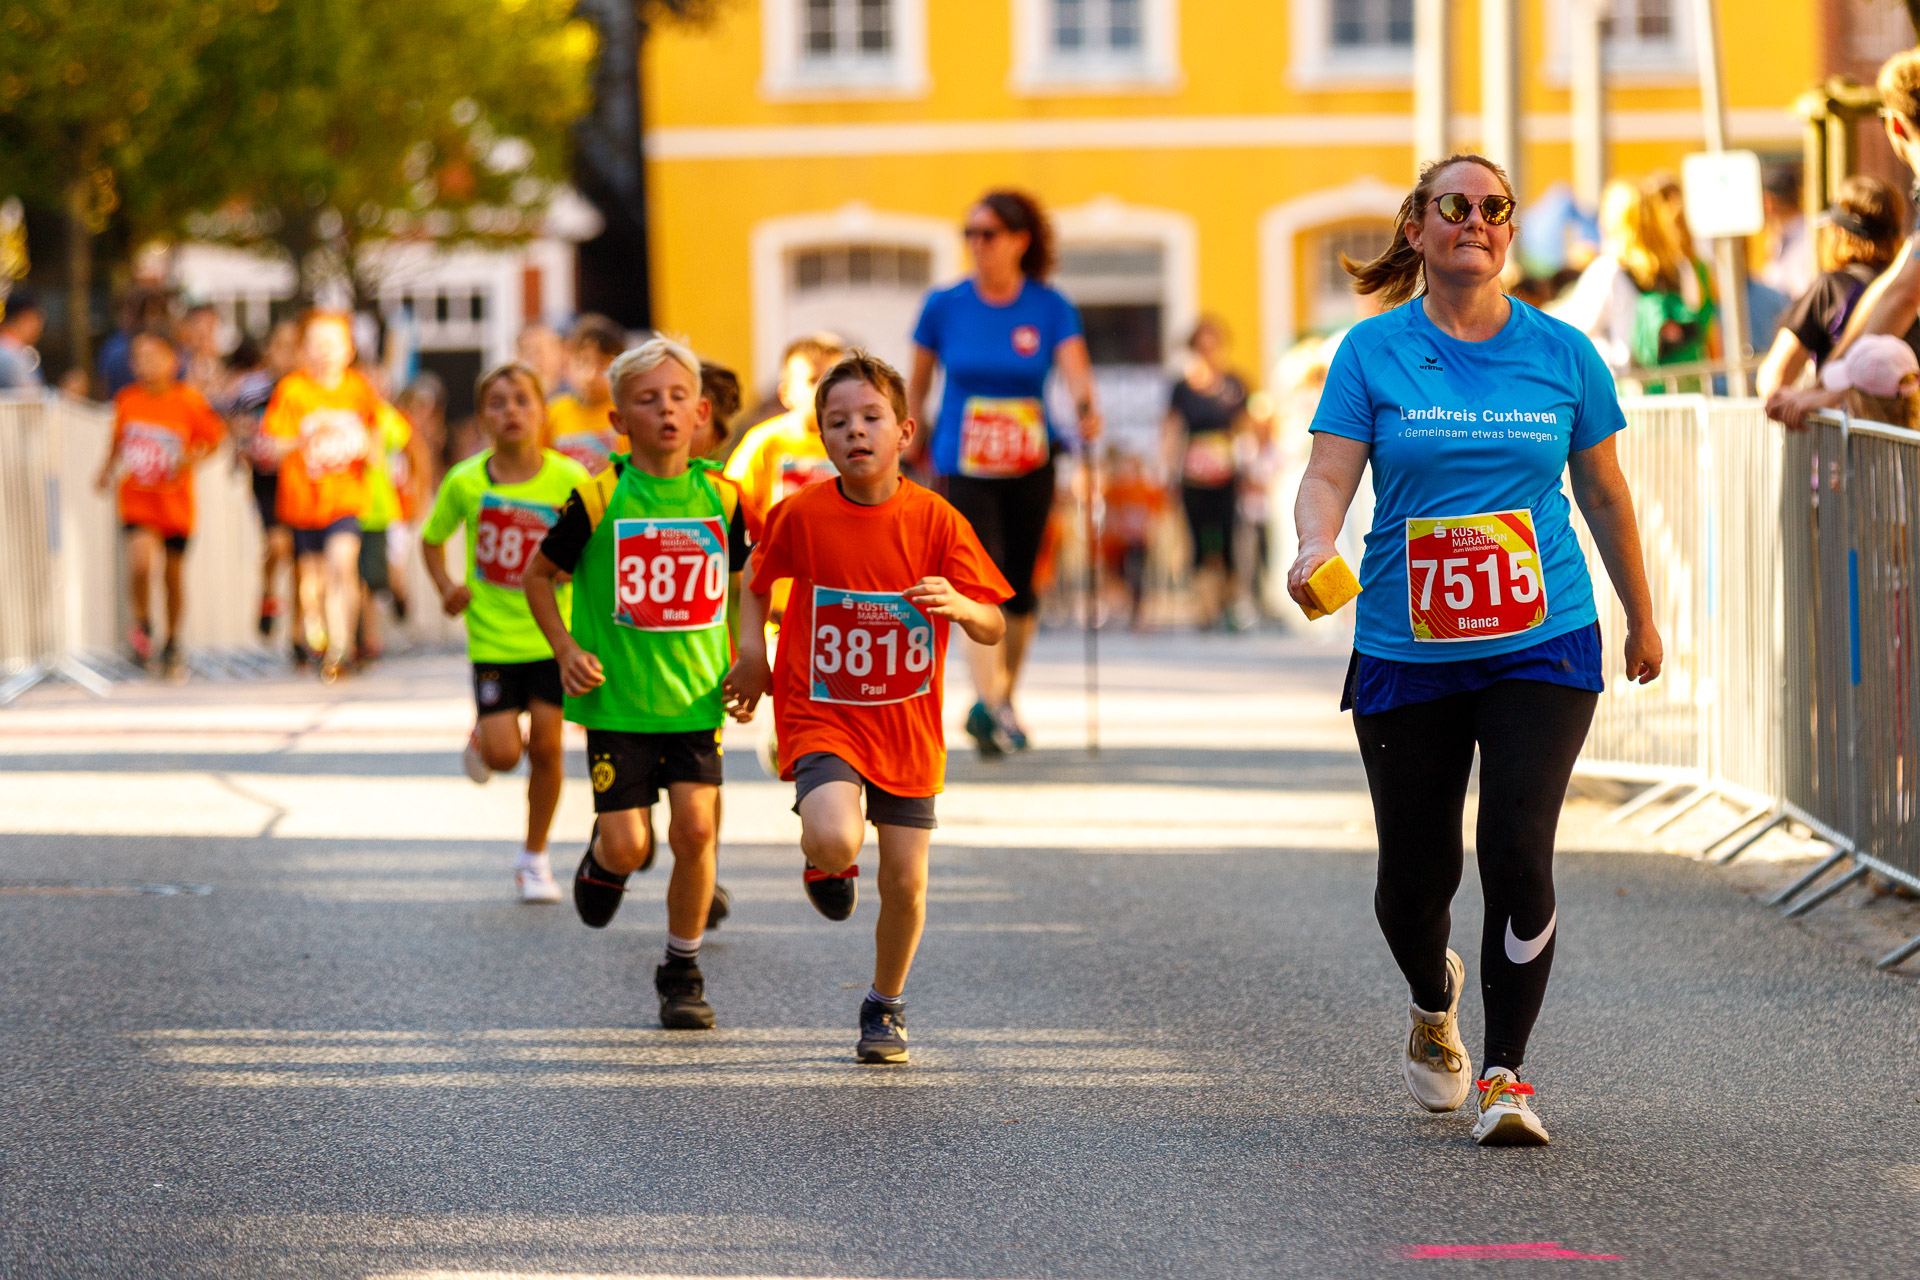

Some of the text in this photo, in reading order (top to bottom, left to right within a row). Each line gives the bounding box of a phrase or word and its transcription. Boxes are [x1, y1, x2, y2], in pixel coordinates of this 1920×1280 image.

[1419, 364, 1444, 372] erima
[1399, 405, 1558, 425] Landkreis Cuxhaven
[1404, 427, 1468, 439] Gemeinsam
[1471, 430, 1505, 440] etwas
[1507, 429, 1552, 443] bewegen
[1450, 523, 1495, 538] KÜSTEN
[1451, 532, 1508, 548] MARATHON
[619, 552, 725, 605] 3870
[1411, 550, 1540, 611] 7515
[857, 600, 899, 612] KÜSTEN
[857, 611, 911, 621] MARATHON
[1457, 616, 1500, 630] Bianca
[815, 624, 931, 677] 3818
[860, 683, 887, 696] Paul
